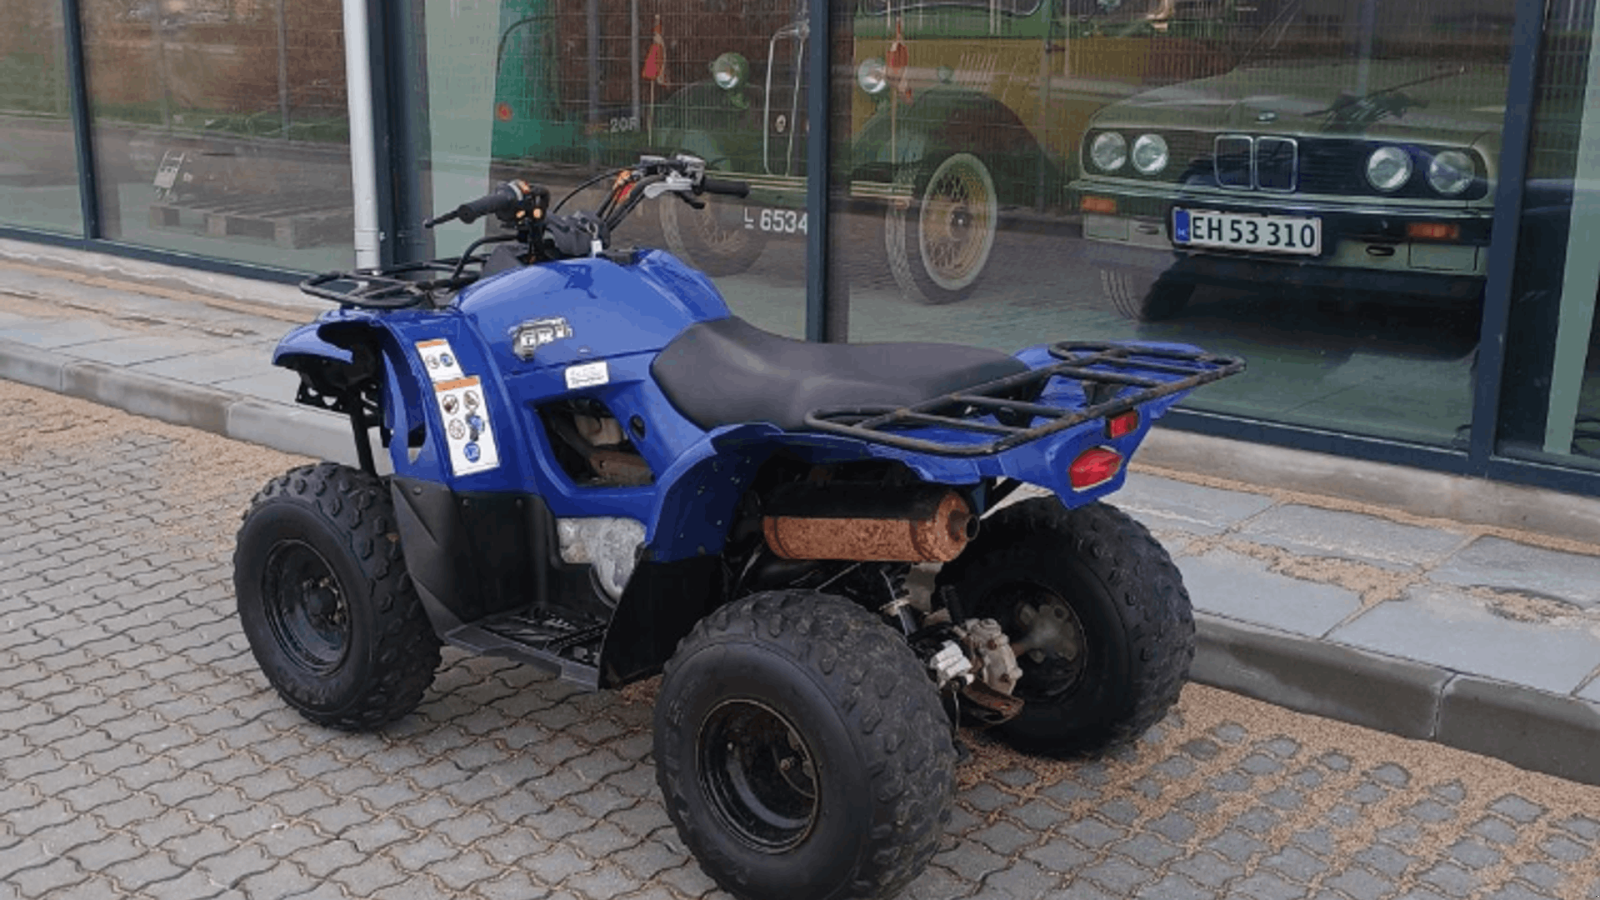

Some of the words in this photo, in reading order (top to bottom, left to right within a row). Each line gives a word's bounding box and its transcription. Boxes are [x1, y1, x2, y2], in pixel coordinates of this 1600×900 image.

[760, 208, 808, 235] 6534
[1192, 216, 1222, 241] EH
[1229, 219, 1259, 244] 53
[1267, 222, 1315, 248] 310
